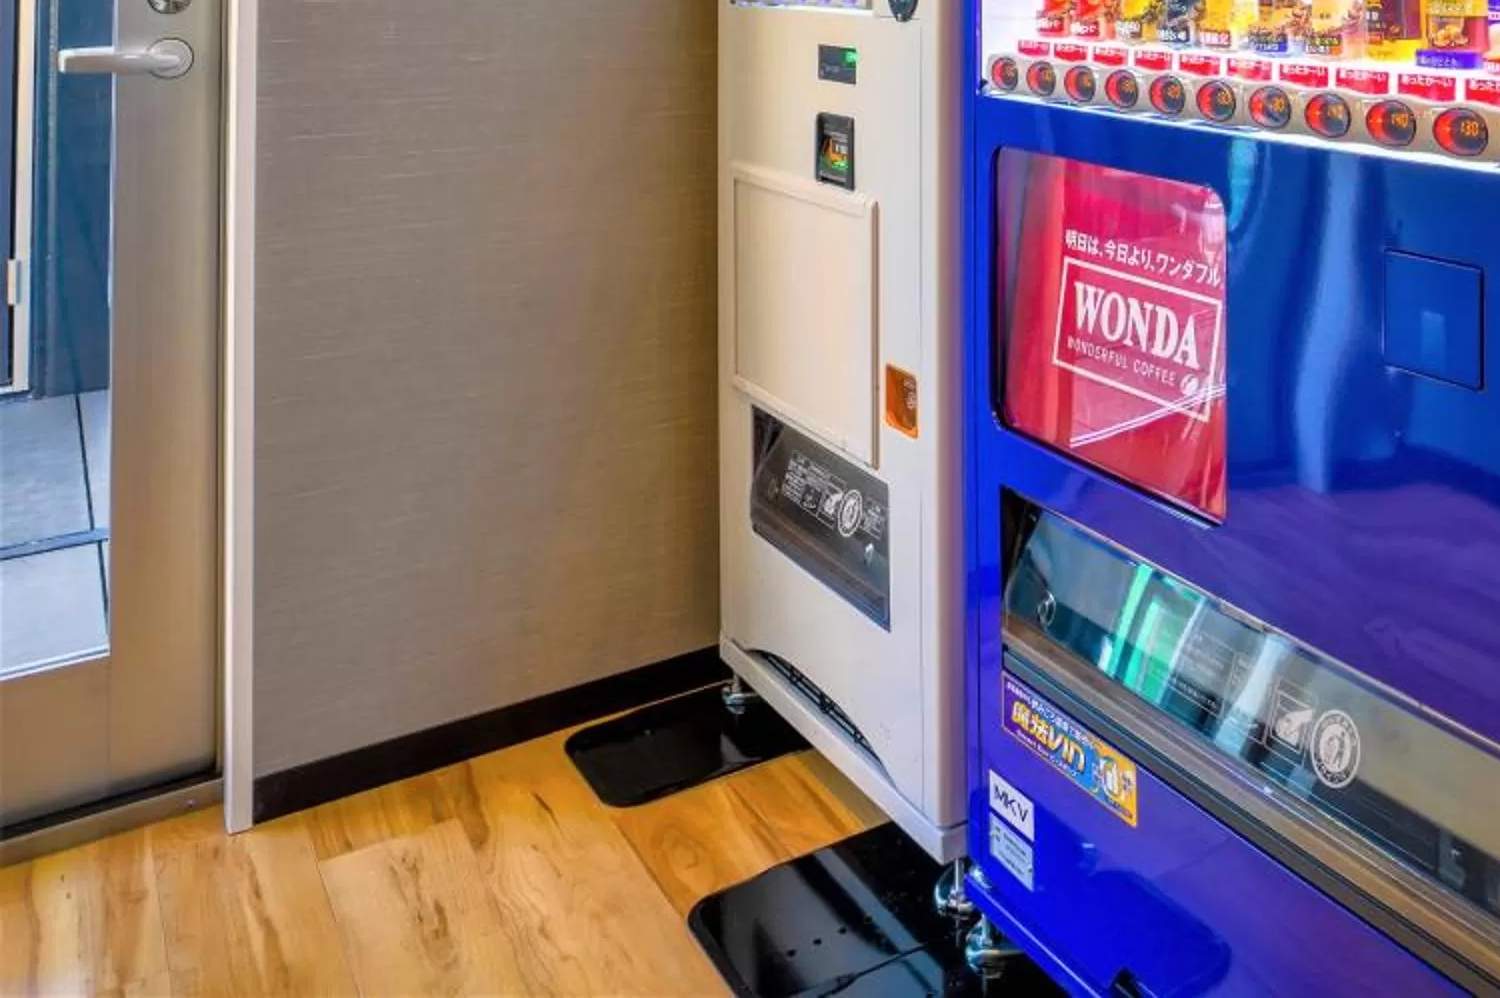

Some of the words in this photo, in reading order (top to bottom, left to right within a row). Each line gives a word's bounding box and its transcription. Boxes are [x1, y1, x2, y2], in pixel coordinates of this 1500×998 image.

[1073, 280, 1201, 370] WONDA
[1066, 334, 1130, 369] WONDERFUL
[1132, 358, 1177, 388] COFFEE
[993, 782, 1030, 825] MKV
